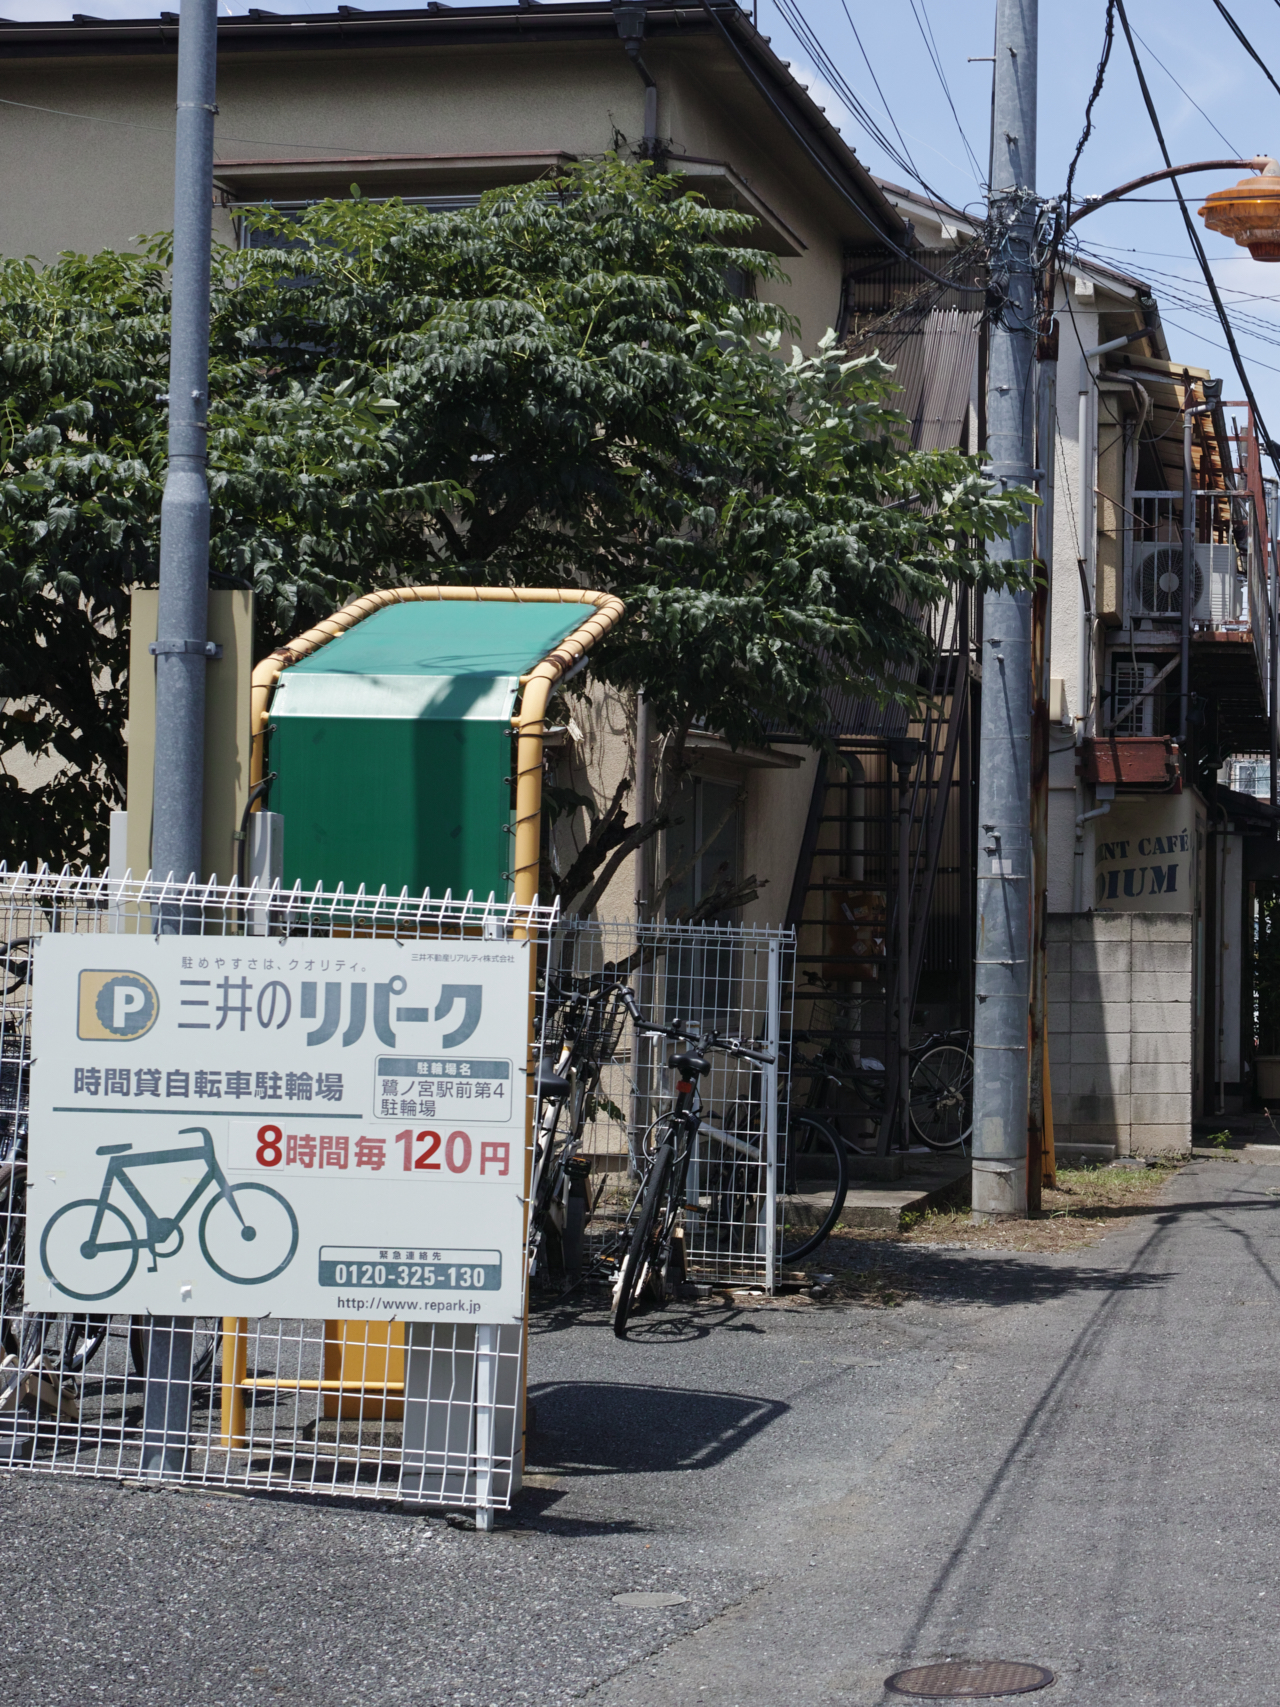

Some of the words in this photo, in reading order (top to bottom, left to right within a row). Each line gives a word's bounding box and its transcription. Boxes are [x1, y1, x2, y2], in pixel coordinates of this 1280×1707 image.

[1096, 841, 1130, 864] NT
[1138, 827, 1189, 856] CAFÉ
[181, 956, 367, 973] 駐めやすさは、クオリティ。
[411, 953, 515, 964] 三井不動産リアルティ株式会社
[112, 985, 146, 1028] P
[178, 974, 483, 1049] 三井のリパーク
[416, 1061, 471, 1076] 駐輪場名
[74, 1066, 344, 1102] 時間貸自転車駐輪場
[380, 1098, 437, 1118] 駐輪場
[379, 1250, 442, 1262] 緊急連絡先
[334, 1264, 485, 1288] 0120-325-130
[337, 1296, 482, 1313] http://www.repark.jp
